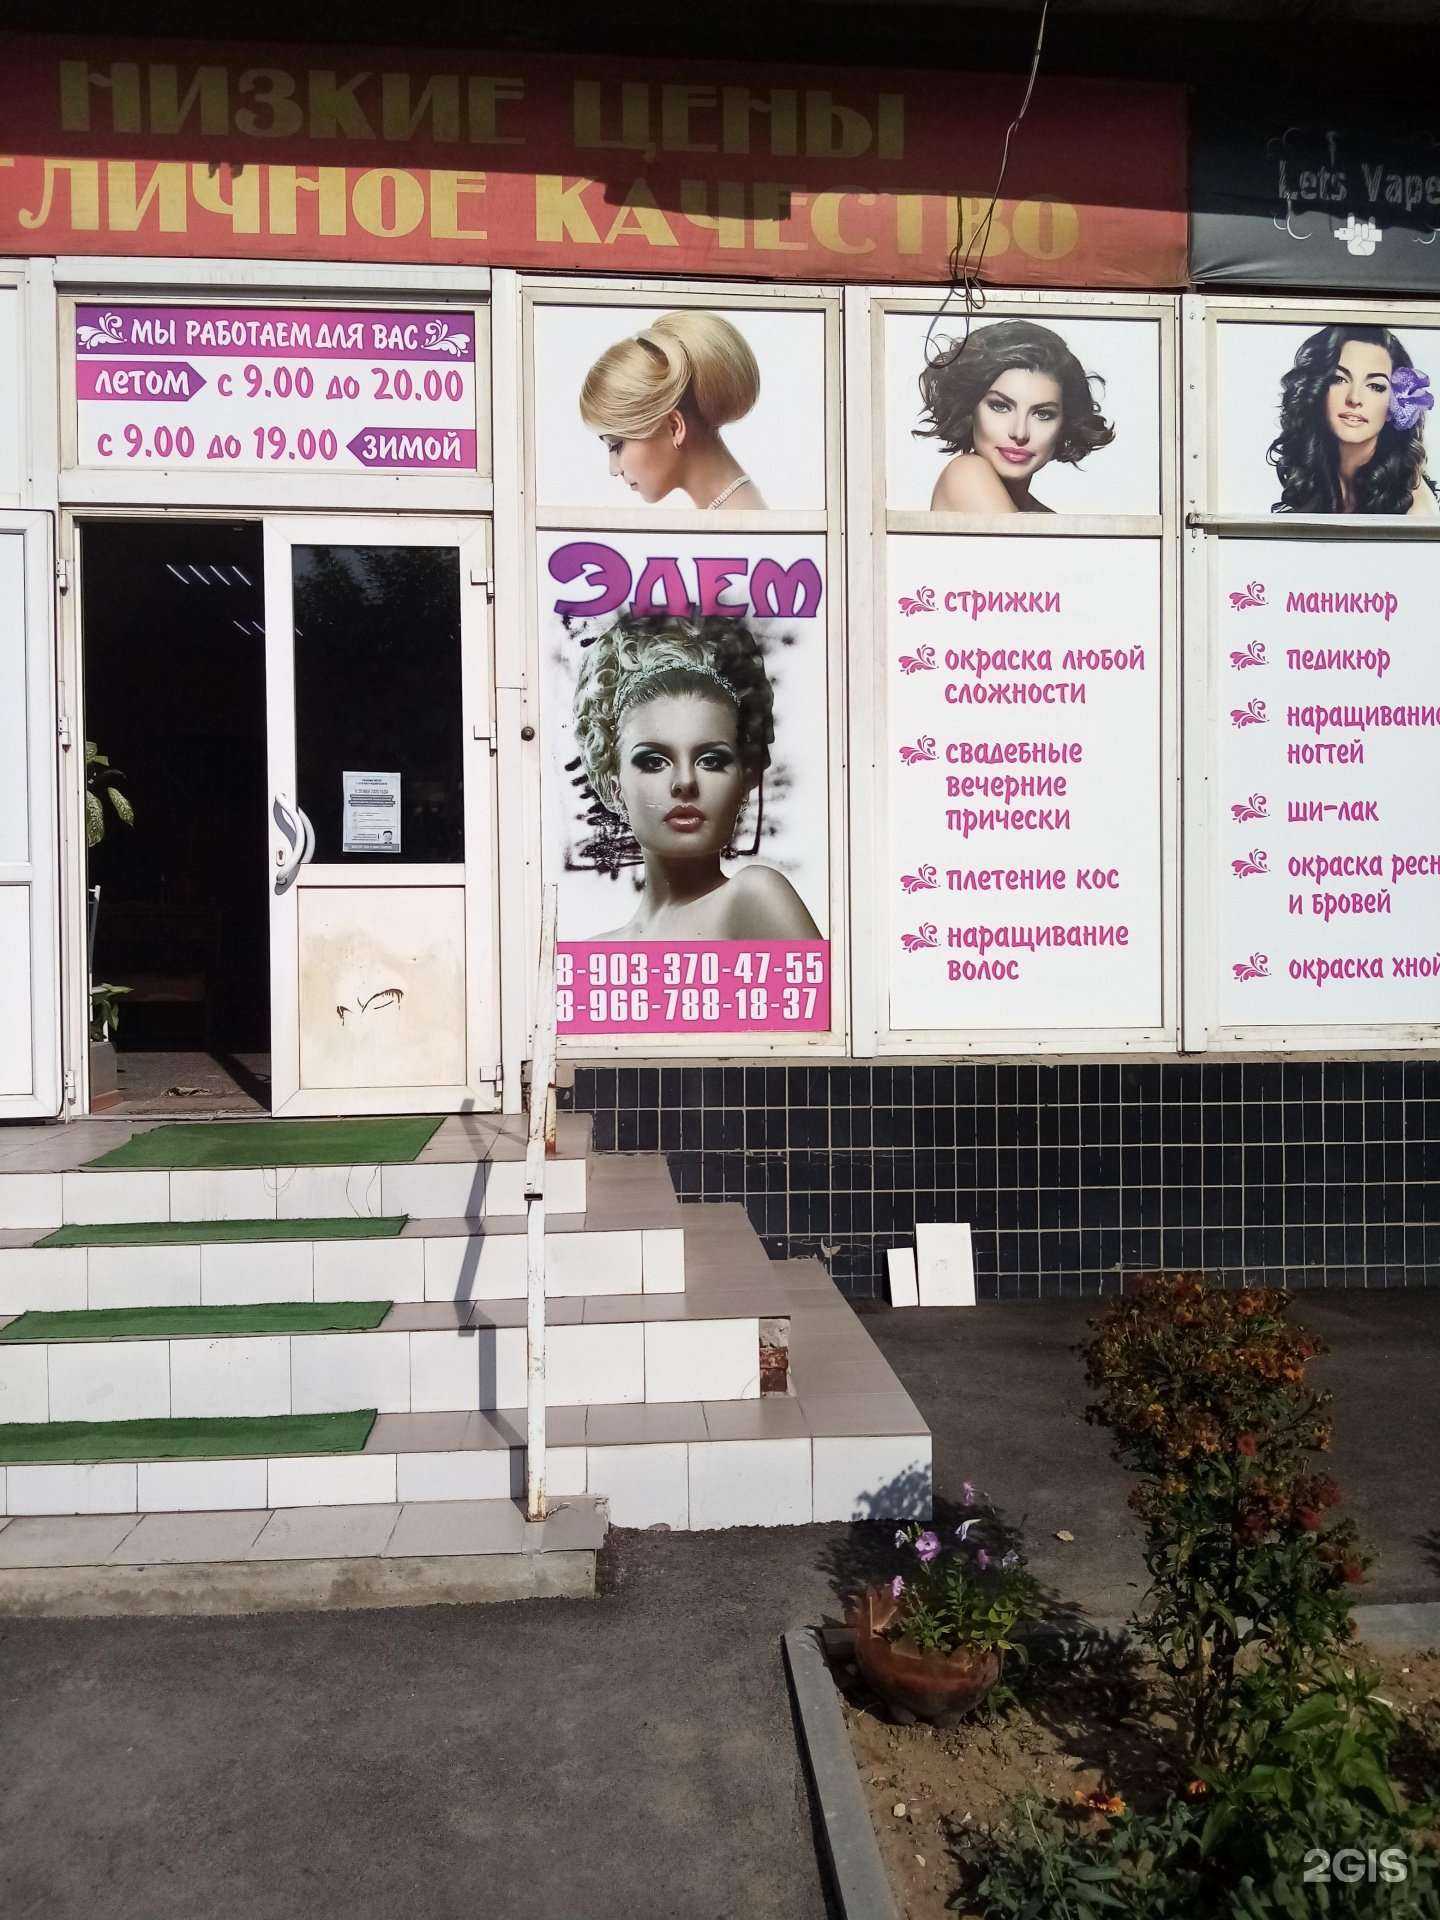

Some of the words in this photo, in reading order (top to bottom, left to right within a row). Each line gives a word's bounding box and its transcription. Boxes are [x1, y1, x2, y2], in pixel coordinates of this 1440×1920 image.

[59, 60, 527, 145] НИЗКИЕ
[573, 80, 904, 162] ЦЕНЫ
[1360, 162, 1440, 212] Vape
[0, 157, 488, 240] ЛИЧНОЕ
[535, 173, 1080, 260] КАЧЕСТВО
[131, 318, 175, 345] МЫ
[186, 319, 312, 349] РАБОТАЕМ
[314, 322, 364, 350] ДЛЯ
[374, 323, 418, 351] ВАС
[217, 374, 233, 398] с
[243, 363, 314, 399] 9.00
[325, 375, 360, 400] до
[371, 367, 464, 402] 20.00
[97, 433, 113, 457] с
[123, 423, 195, 460] 9.00
[206, 434, 241, 460] до
[252, 426, 338, 461] 19.00
[548, 541, 823, 618] ЭДЕМ
[944, 589, 1061, 621] стрижки
[1286, 591, 1398, 622] маникюр
[944, 647, 1052, 679] окраска
[1062, 644, 1146, 671] любой
[1286, 648, 1391, 679] педикюр
[944, 682, 1086, 705] сложности
[945, 742, 1083, 765] свадебные
[1287, 738, 1364, 765] ногтей
[945, 774, 1067, 806] вечерние
[945, 808, 1071, 840] прически
[1287, 800, 1380, 823] ши-лак
[946, 868, 1066, 891] плетение
[1076, 868, 1120, 890] кос
[1288, 854, 1384, 885] окраска
[1288, 893, 1303, 915] и
[1312, 888, 1391, 923] бровей
[947, 924, 1129, 956] наращивание
[556, 951, 824, 986] 8-903-370-47-55
[946, 959, 1020, 981] волос
[1288, 956, 1384, 988] окраска
[556, 987, 818, 1022] 8-966-788-18-37
